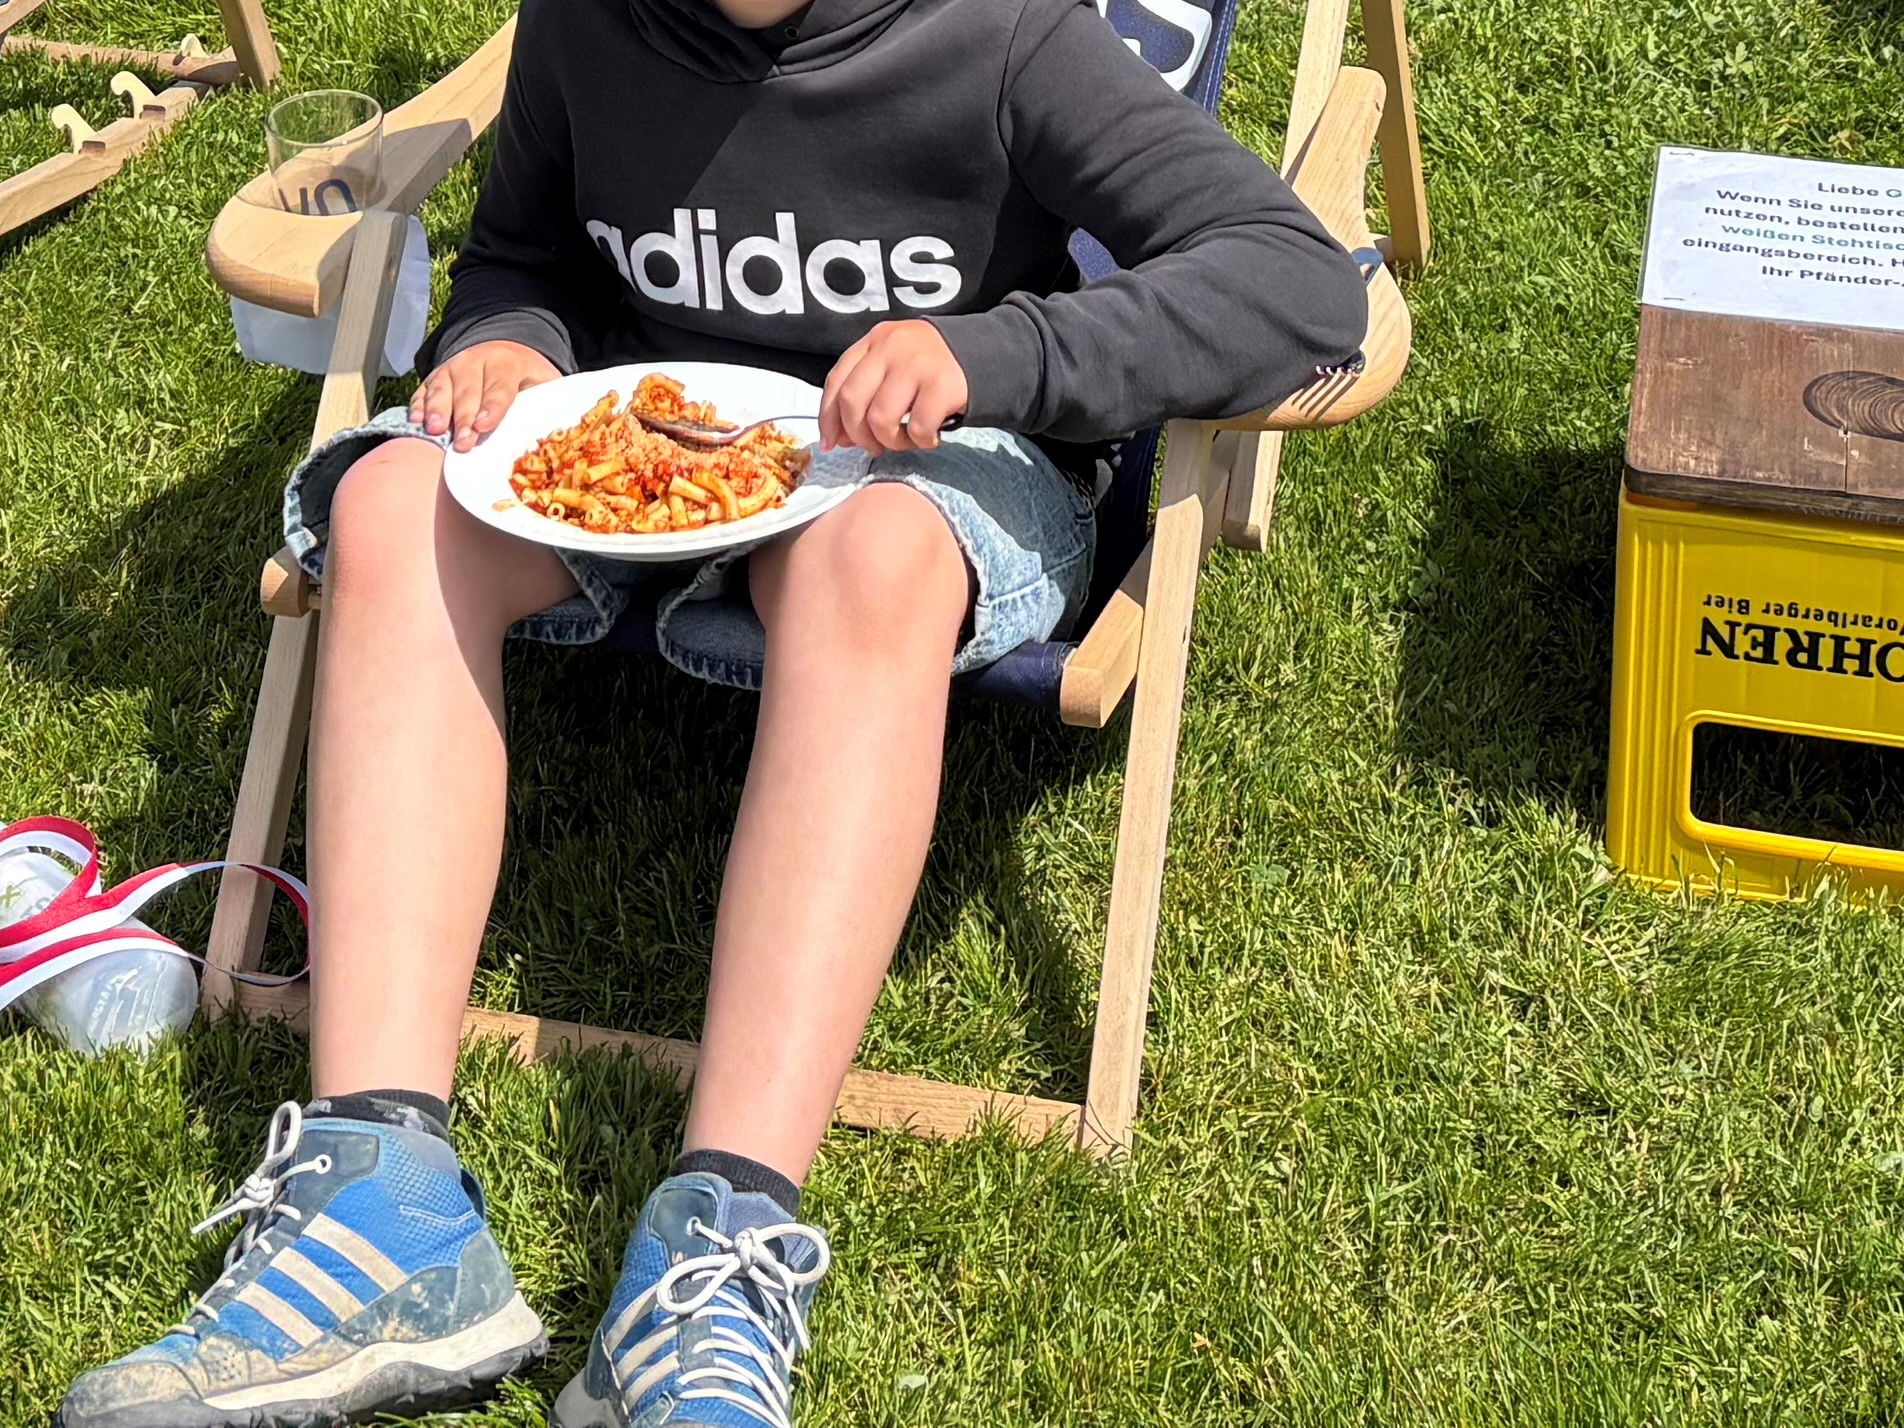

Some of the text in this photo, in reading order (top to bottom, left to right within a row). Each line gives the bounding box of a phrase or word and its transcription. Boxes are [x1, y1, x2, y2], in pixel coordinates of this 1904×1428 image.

[1716, 189, 1781, 206] Wenn
[1788, 198, 1823, 210] Sie
[1818, 182, 1878, 196] Liebe
[1705, 206, 1790, 225] nutzen,
[1797, 216, 1904, 234] bestellen
[1722, 224, 1805, 242] weißen
[1683, 237, 1883, 267] eingangsbereich.
[1762, 265, 1793, 277] Ihr
[1702, 593, 1751, 616] Bier
